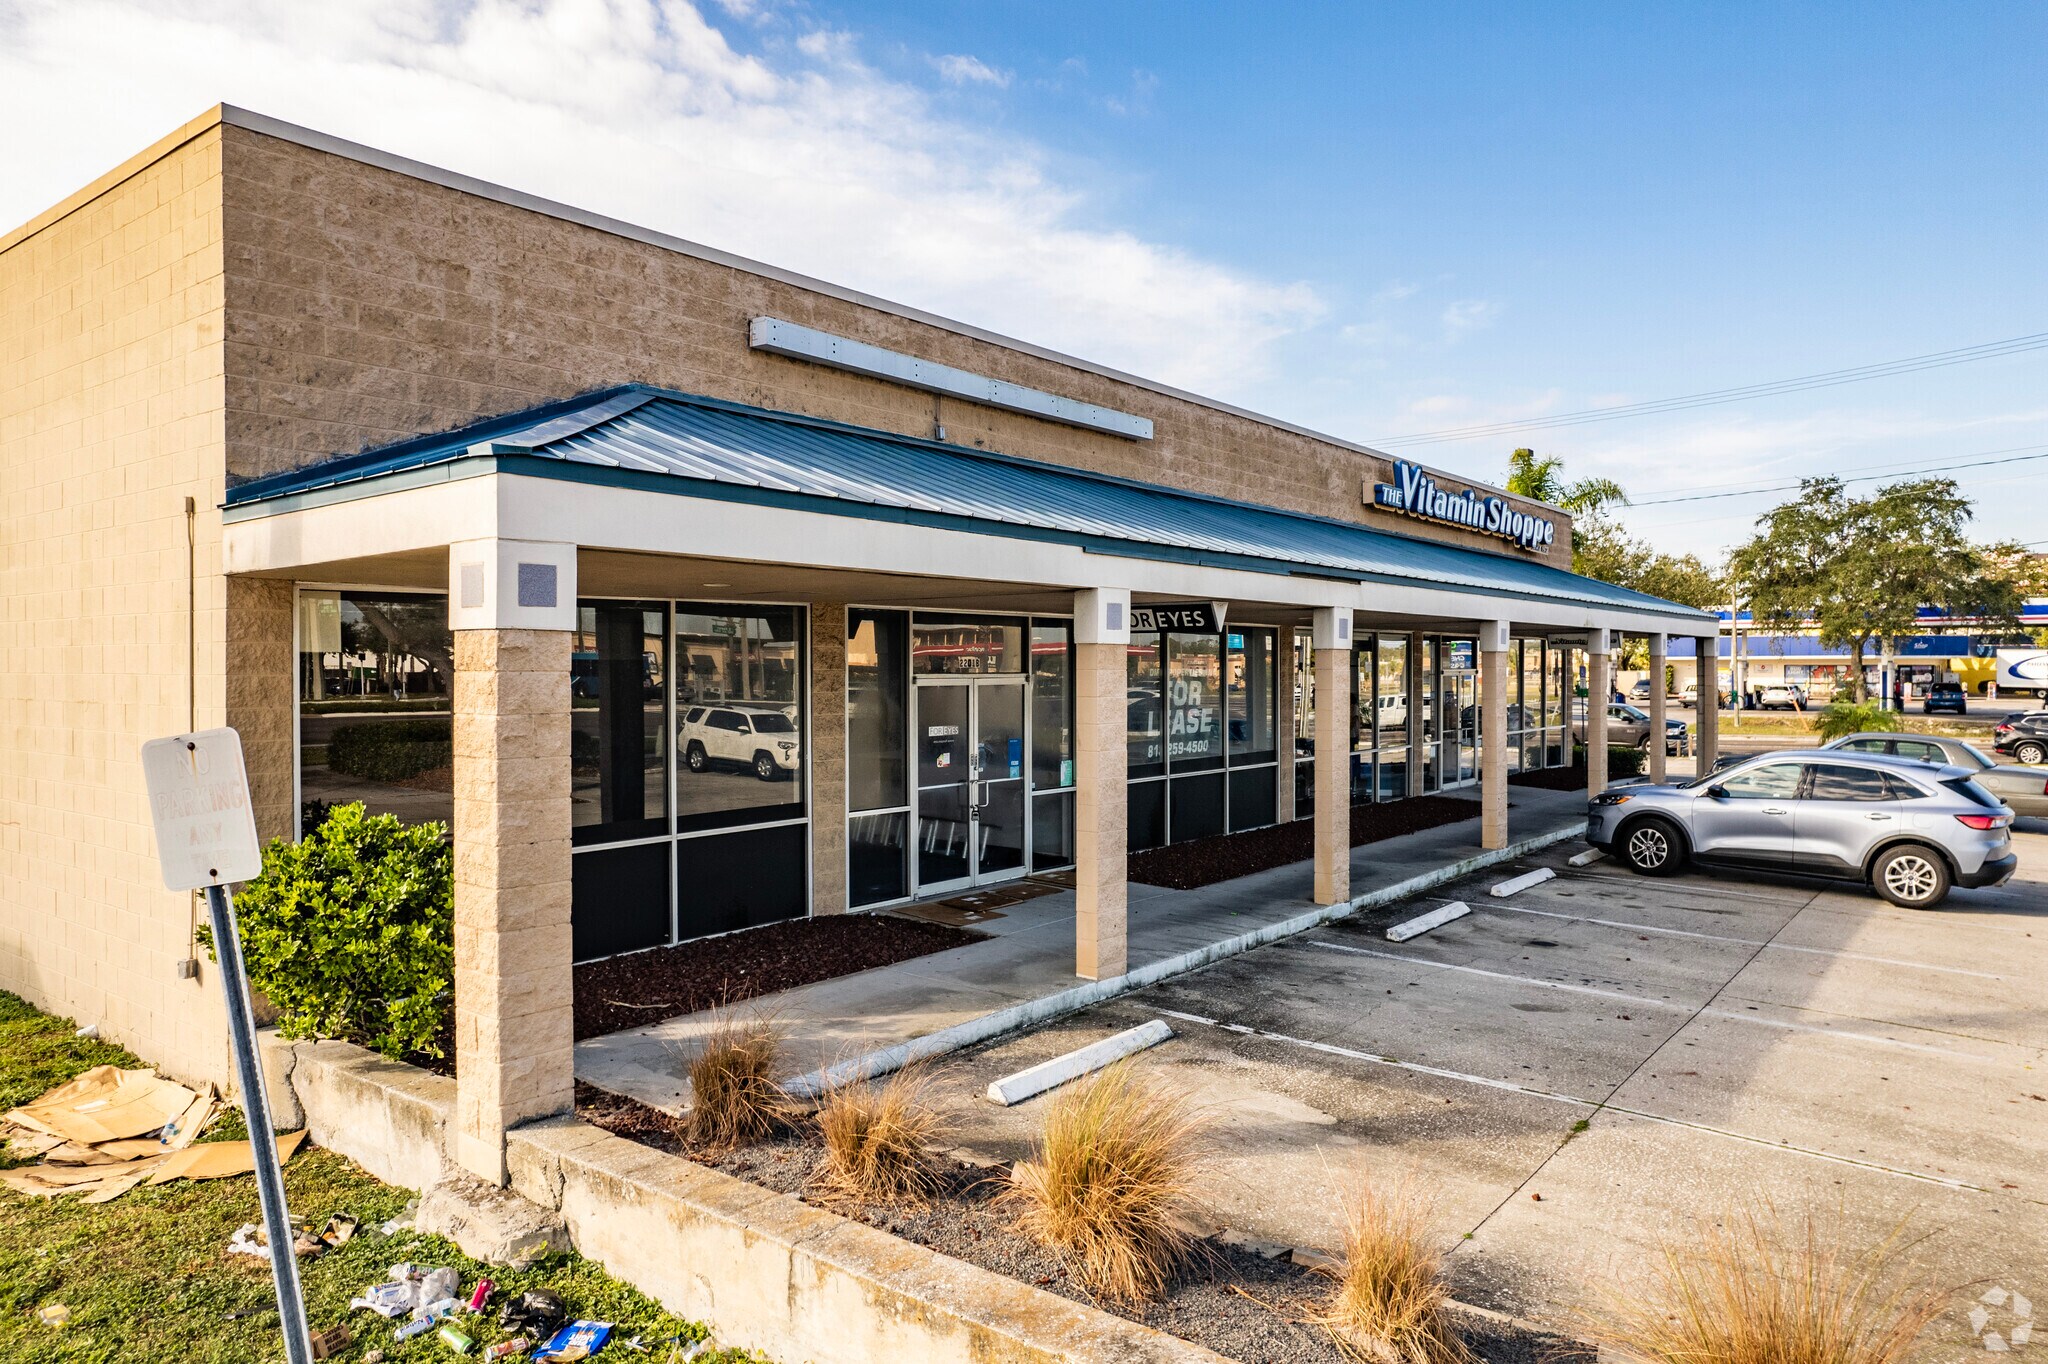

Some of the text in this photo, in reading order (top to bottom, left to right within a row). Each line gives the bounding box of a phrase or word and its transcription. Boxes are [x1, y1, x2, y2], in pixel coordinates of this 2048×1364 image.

[1383, 460, 1555, 547] THE Vitamin Shoppe
[1131, 610, 1205, 628] OR EYES
[929, 726, 959, 737] FOR EYES
[1148, 708, 1214, 737] LASE
[176, 747, 211, 779] NO
[156, 781, 243, 821] PARKING
[189, 823, 223, 846] ANY
[190, 849, 232, 873] TIME
[400, 1318, 424, 1333] Natural
